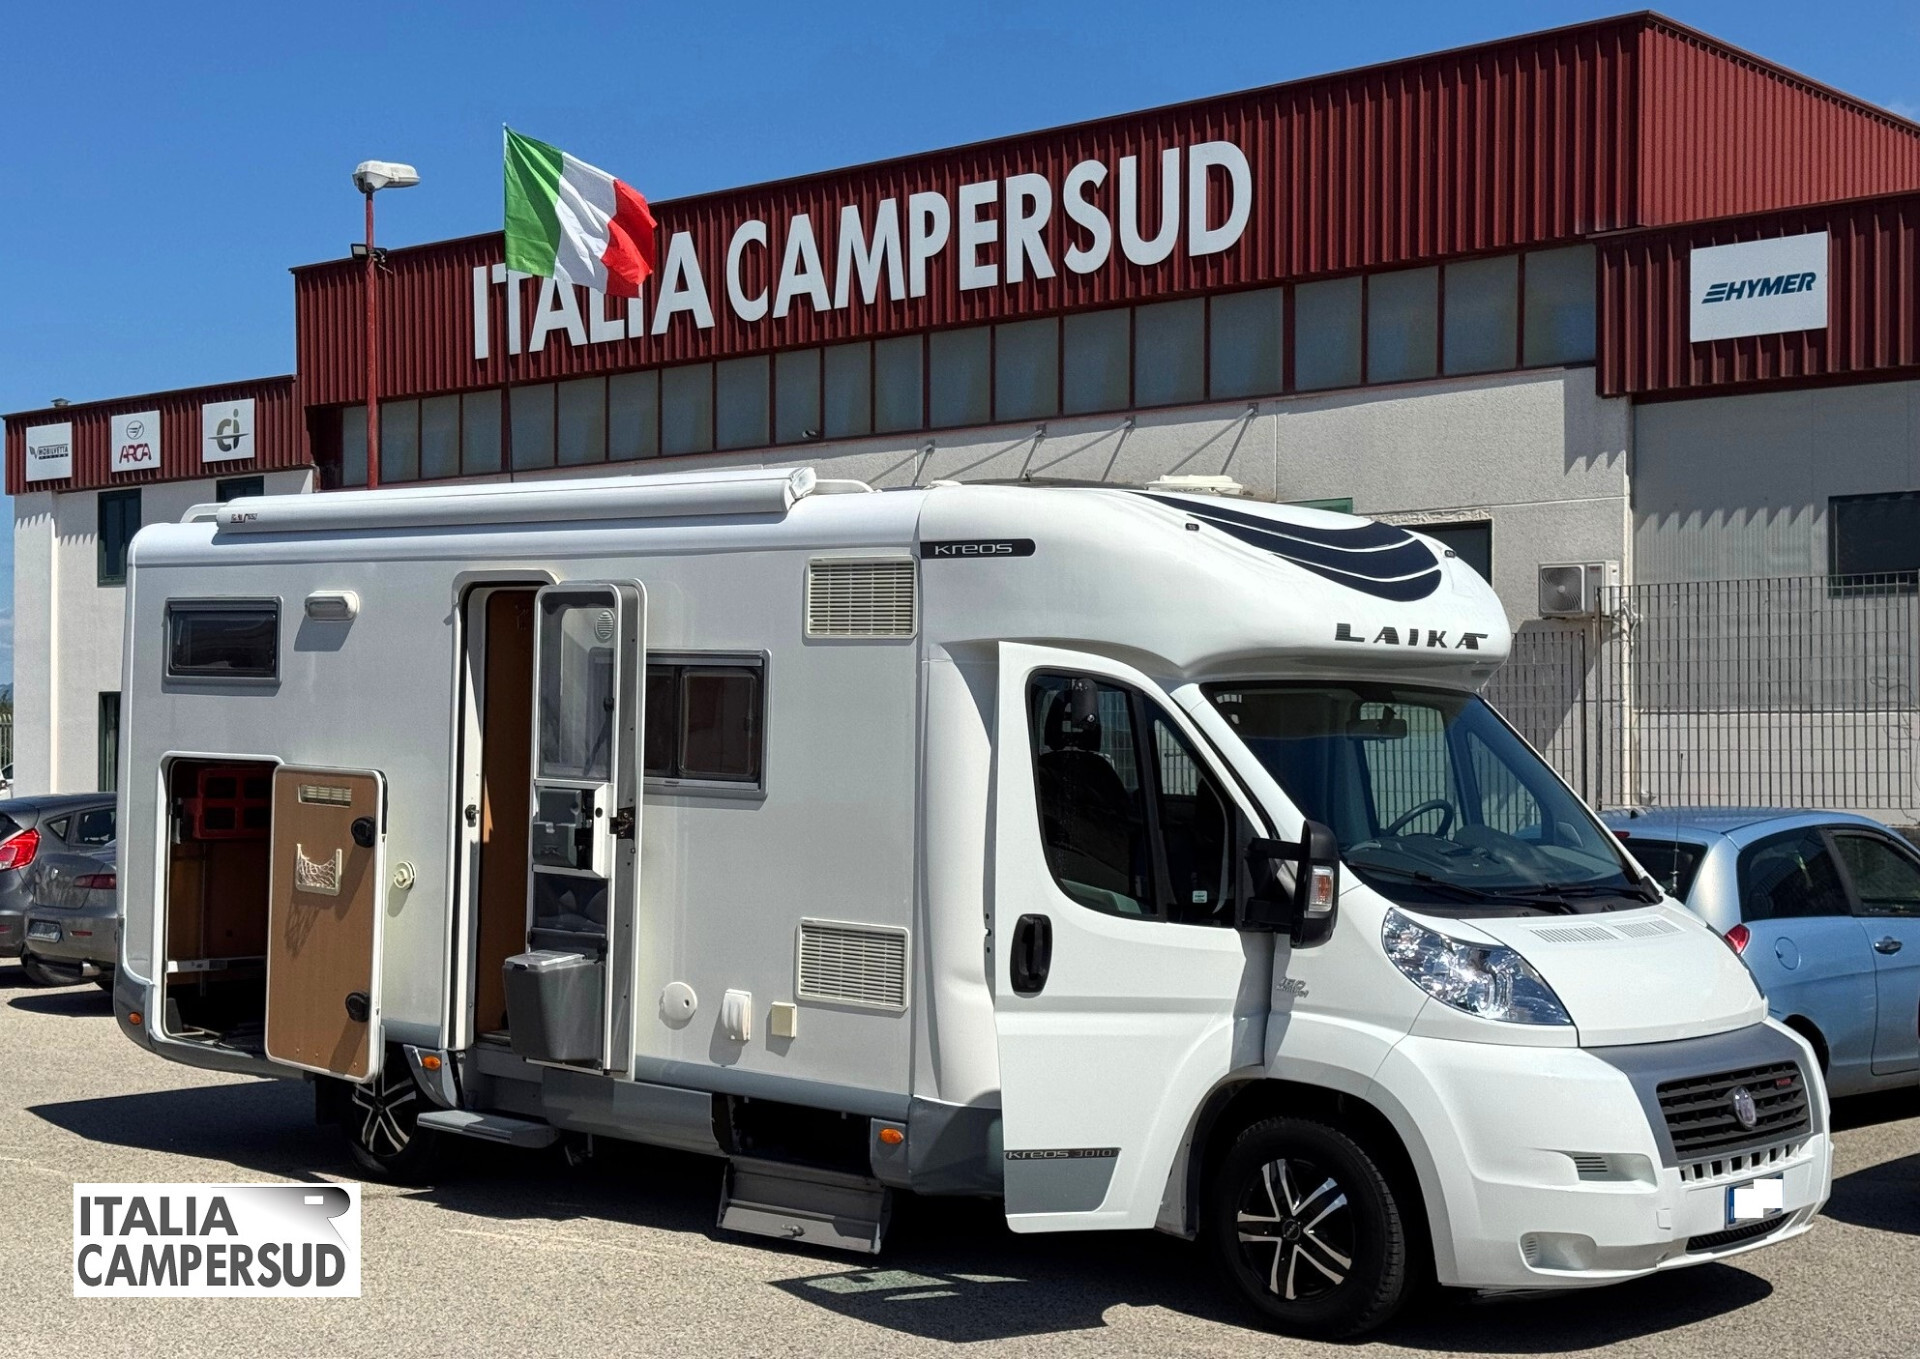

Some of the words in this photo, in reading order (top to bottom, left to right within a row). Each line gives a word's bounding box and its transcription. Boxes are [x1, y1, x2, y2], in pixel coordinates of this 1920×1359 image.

[726, 140, 1253, 322] CAMPERSUD
[1722, 271, 1817, 302] HYMER
[119, 443, 152, 464] ARCA
[1334, 622, 1489, 650] LAIKA
